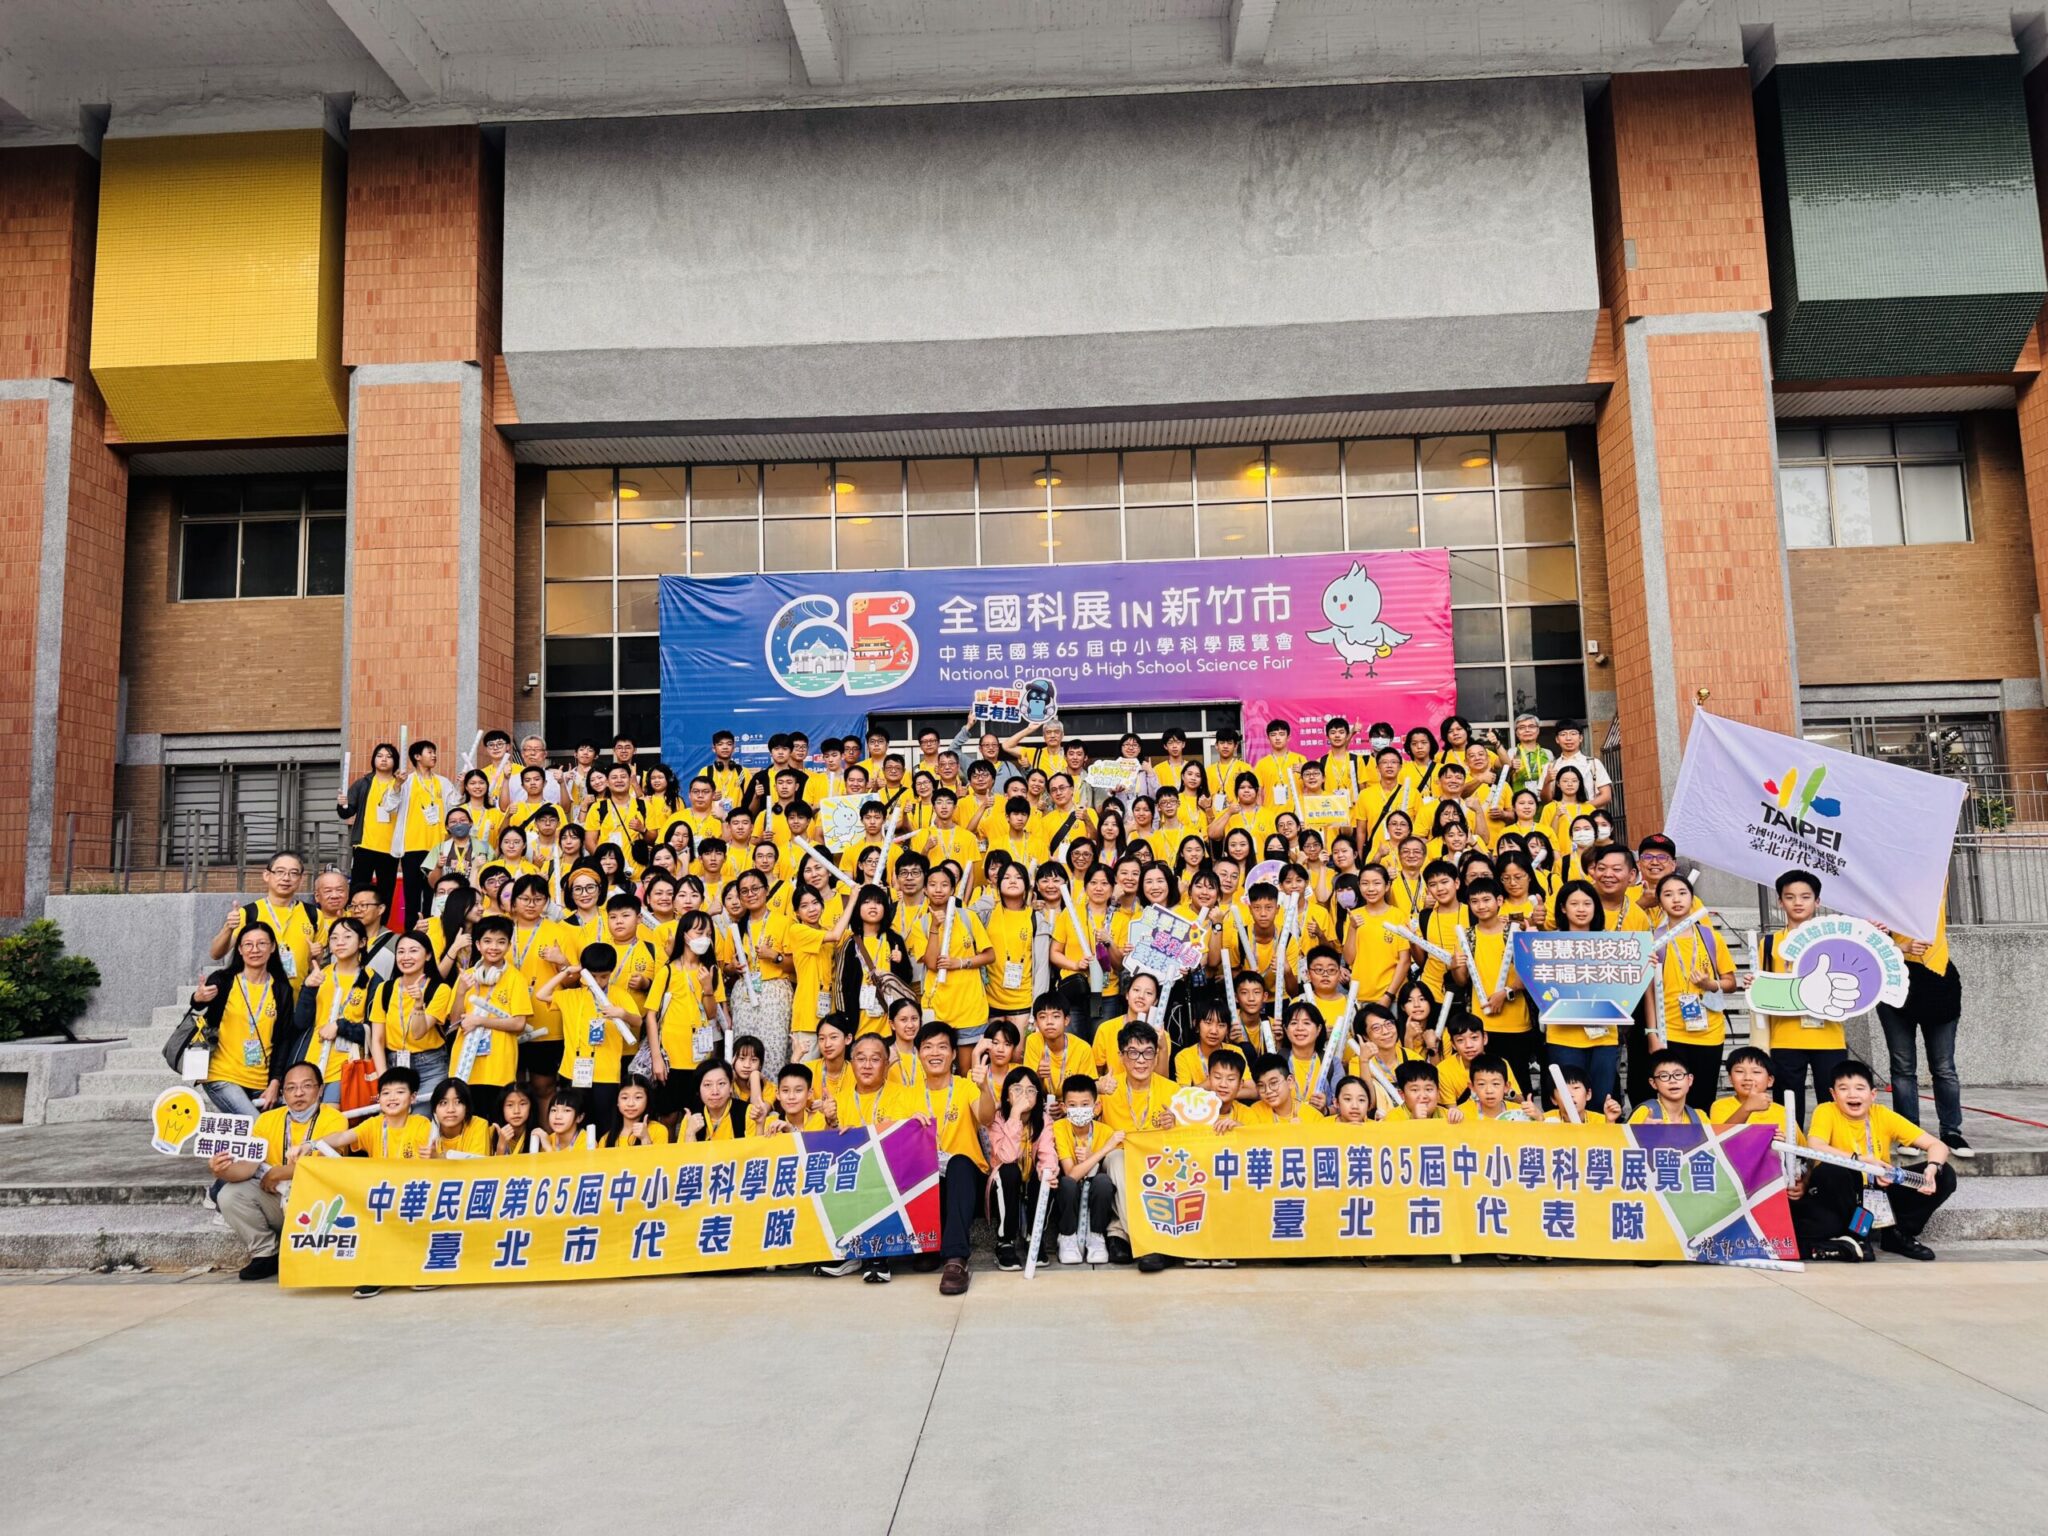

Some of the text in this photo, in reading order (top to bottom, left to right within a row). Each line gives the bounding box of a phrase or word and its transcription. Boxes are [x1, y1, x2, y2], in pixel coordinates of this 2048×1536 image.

[939, 583, 1292, 634] 全國科展 IN 新竹市
[939, 655, 1294, 682] National Primary & High School Science Fair
[1761, 801, 1842, 852] TAIPEI
[1748, 837, 1840, 876] 臺北市代表隊
[1532, 939, 1641, 960] 智慧科技城
[1533, 963, 1641, 984] 幸福未來市
[200, 1116, 250, 1137] 讓學習
[196, 1138, 264, 1160] 無限可能
[1214, 1144, 1716, 1193] 中華民國第65屆中小學科學展覽會
[367, 1149, 862, 1223] 中華民國第65屆中小學科學展覽會
[1152, 1221, 1200, 1236] TAIPEI
[1271, 1196, 1646, 1241] 臺北市代表隊
[291, 1234, 357, 1250] TAIPEI
[423, 1208, 797, 1271] 臺北市代表隊
